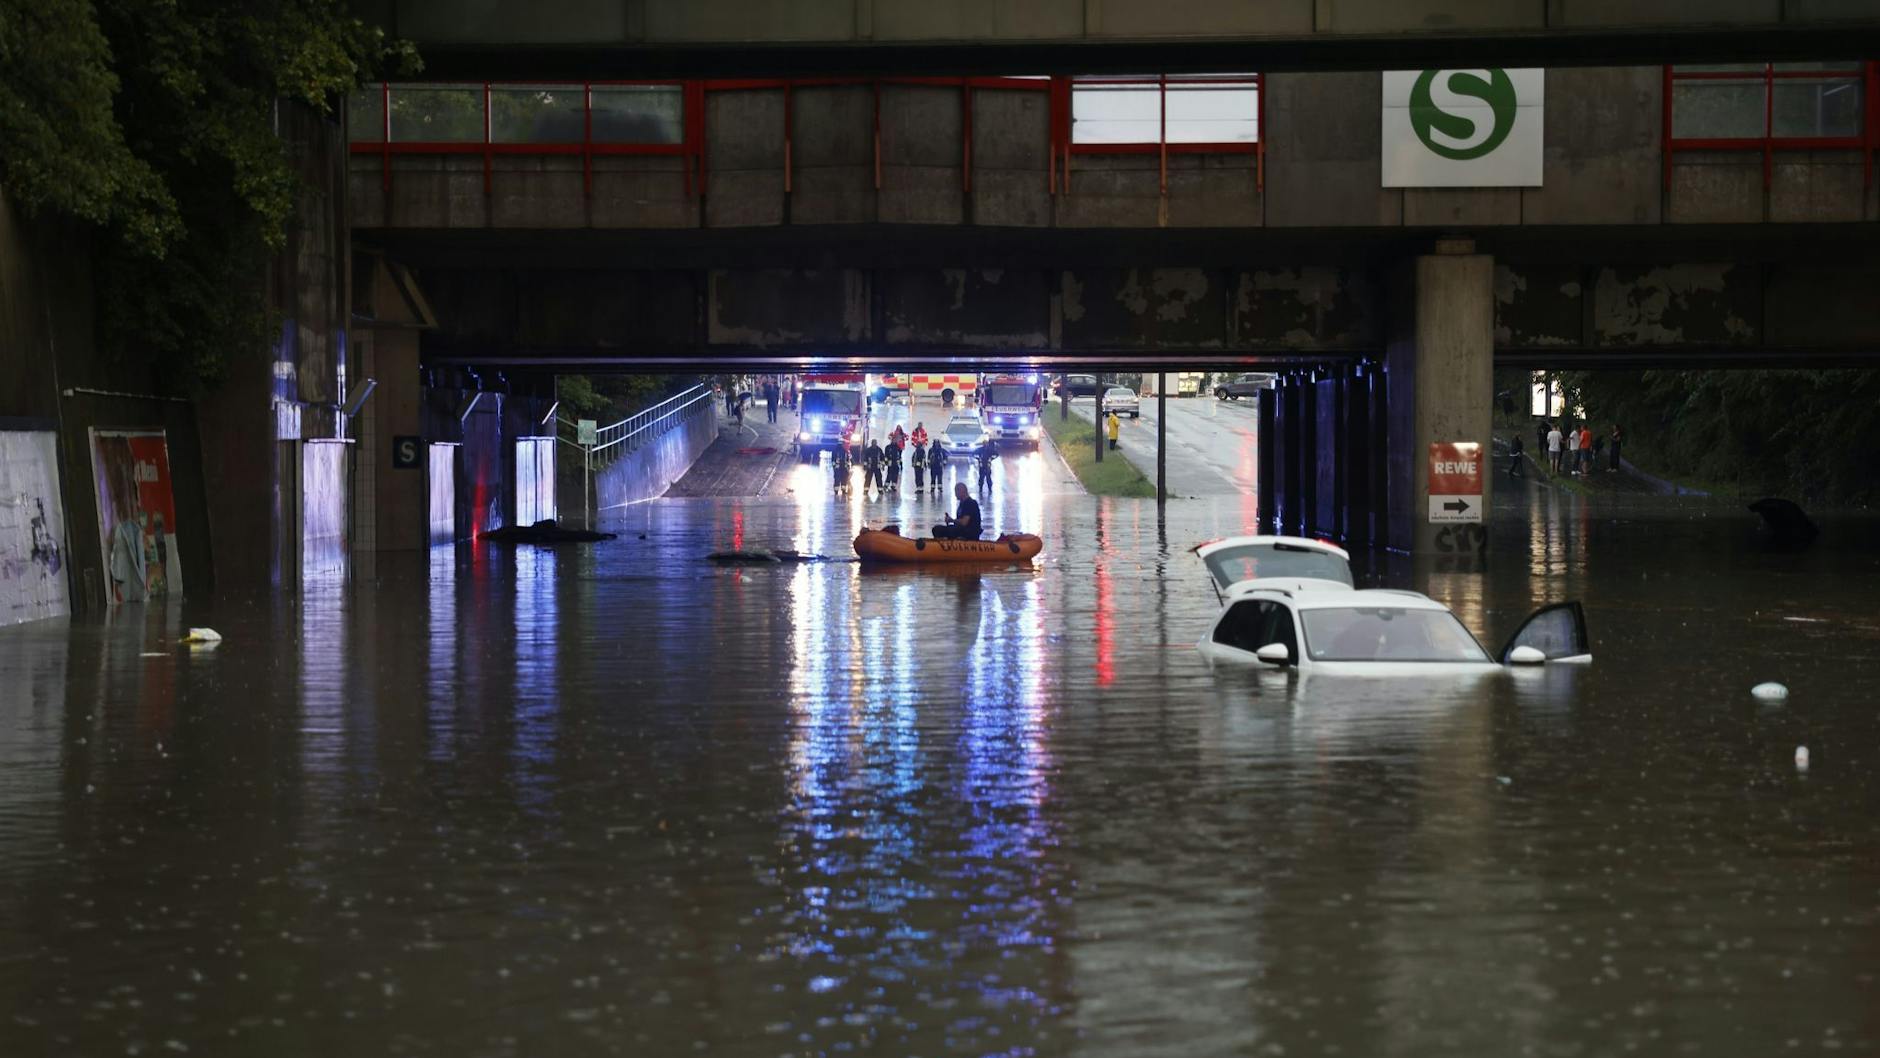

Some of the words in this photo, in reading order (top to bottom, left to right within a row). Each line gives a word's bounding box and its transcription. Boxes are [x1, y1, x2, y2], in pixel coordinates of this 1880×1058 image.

[1429, 69, 1496, 151] S
[399, 441, 416, 463] S
[1434, 462, 1478, 475] REWE
